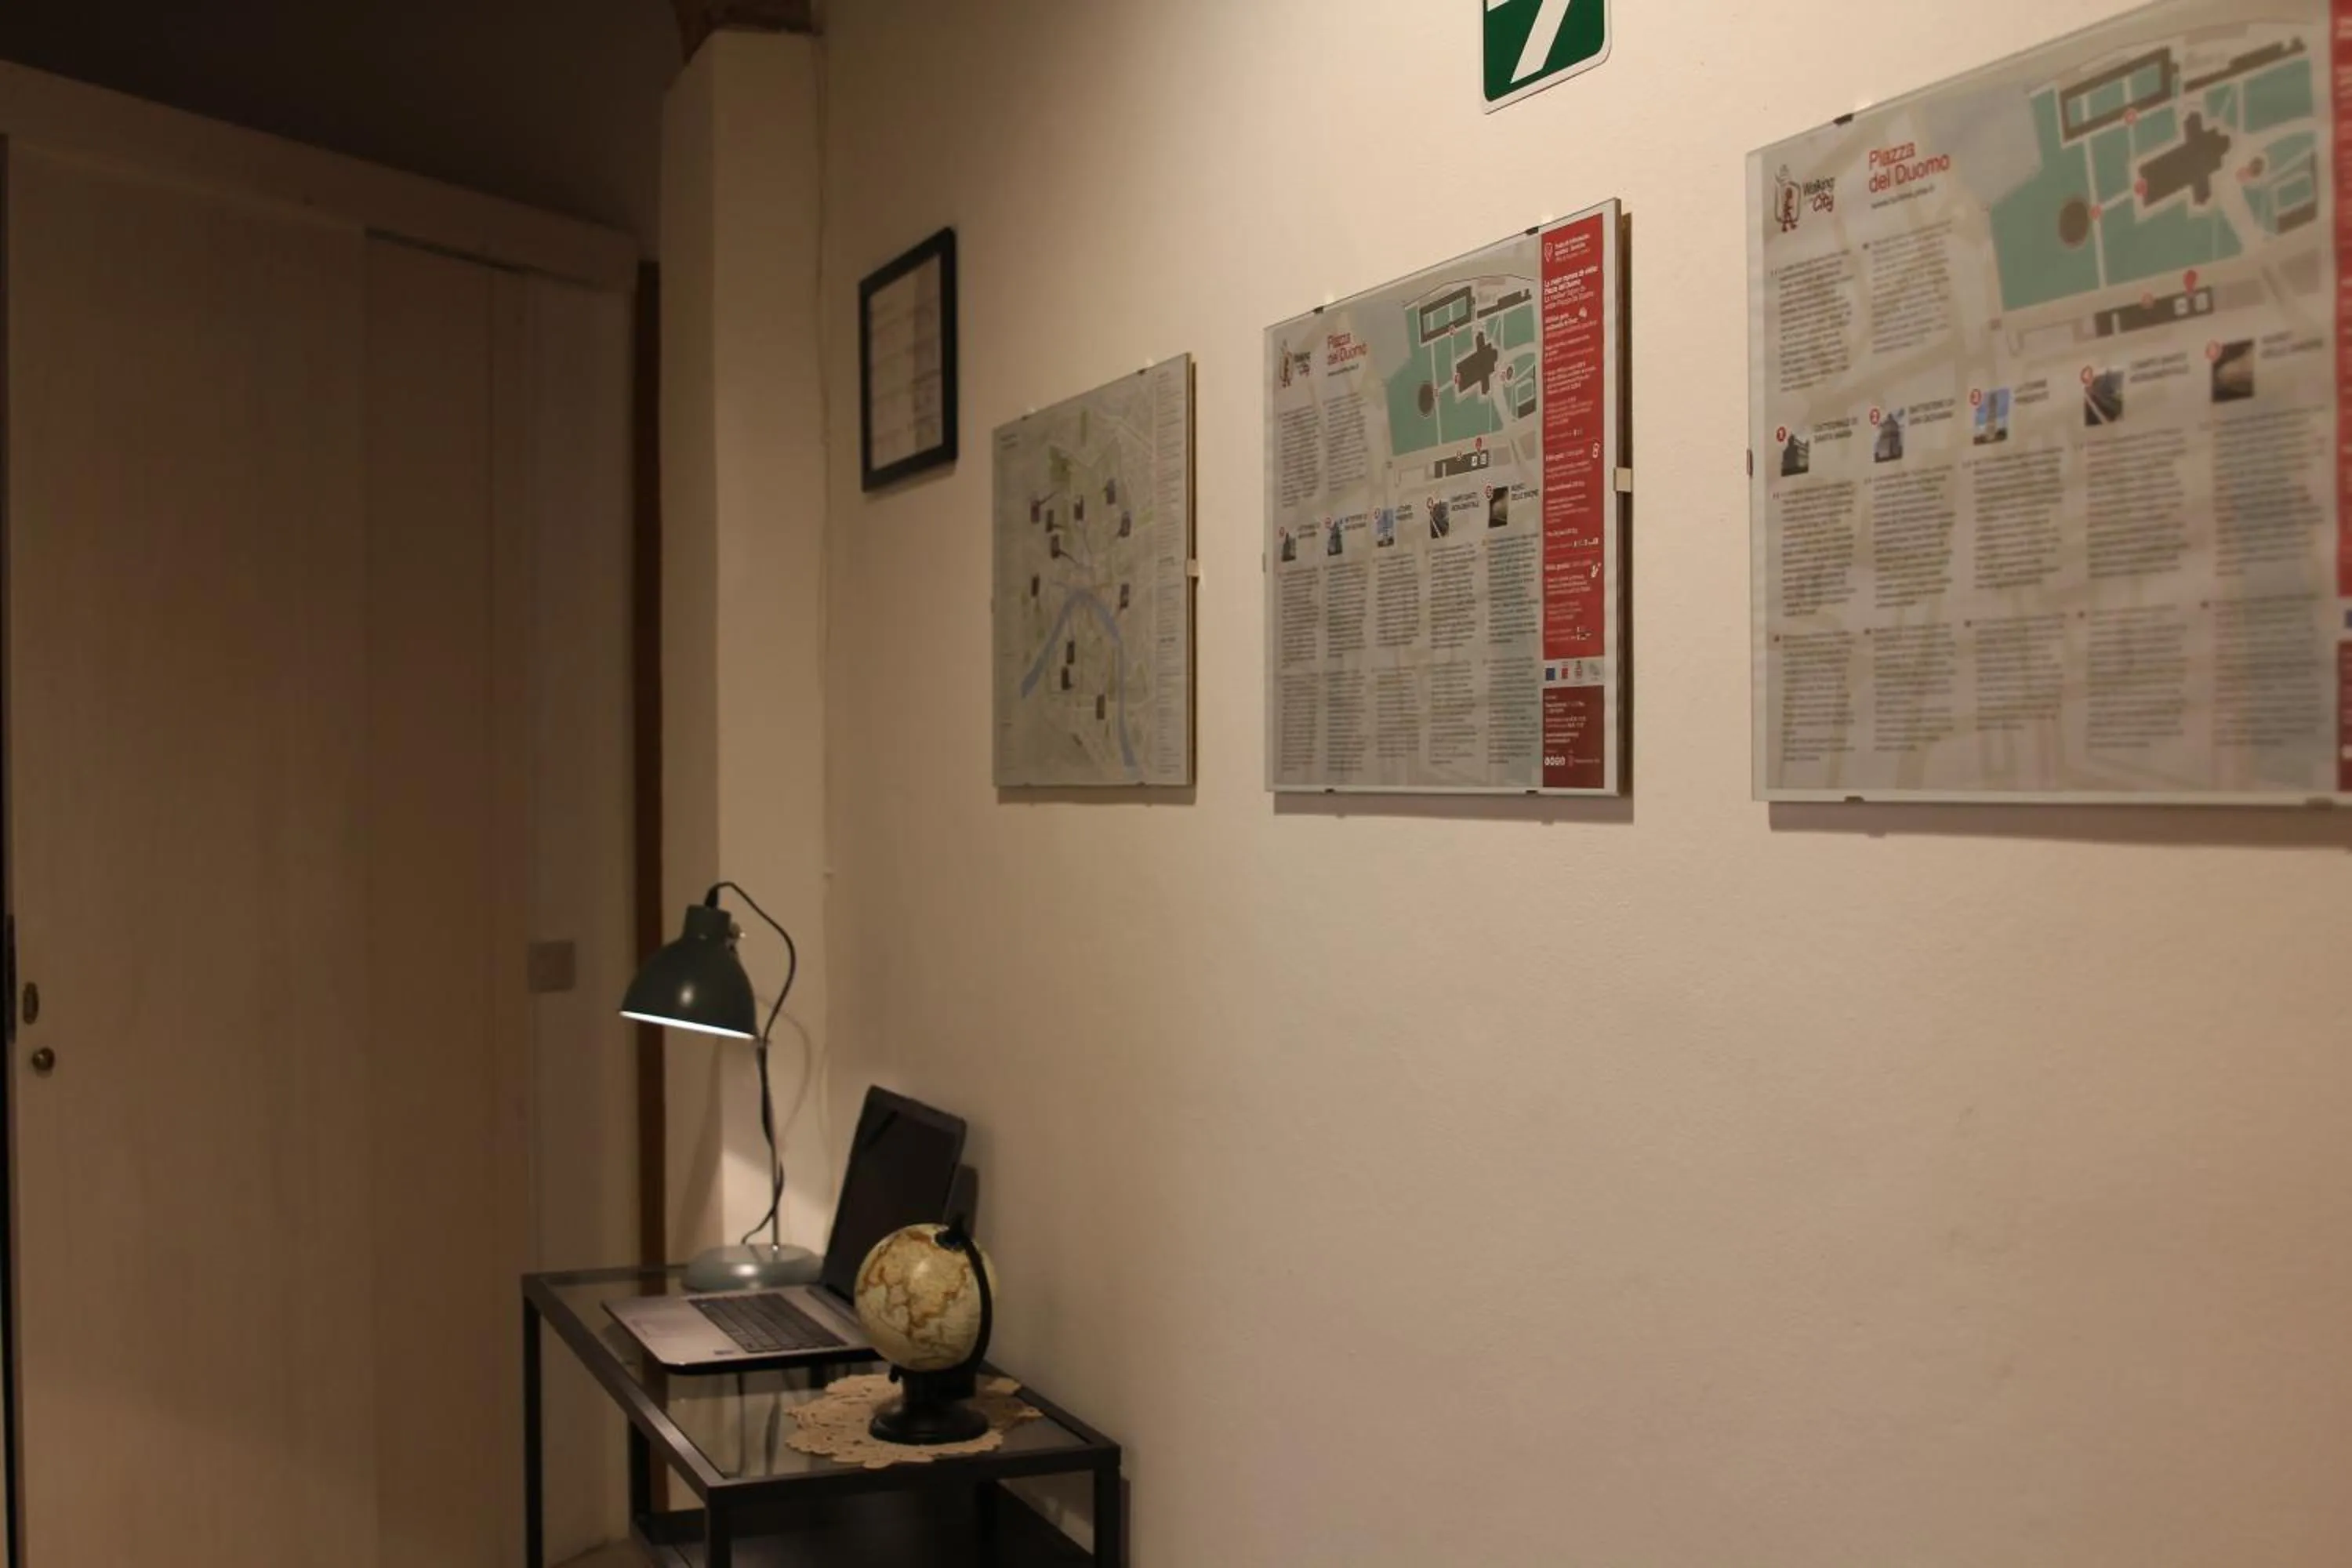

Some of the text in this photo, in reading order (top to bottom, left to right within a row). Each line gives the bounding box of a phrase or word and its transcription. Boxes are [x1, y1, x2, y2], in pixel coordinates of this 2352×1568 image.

[1868, 142, 1915, 171] Piazza
[1868, 154, 1950, 194] del Duomo
